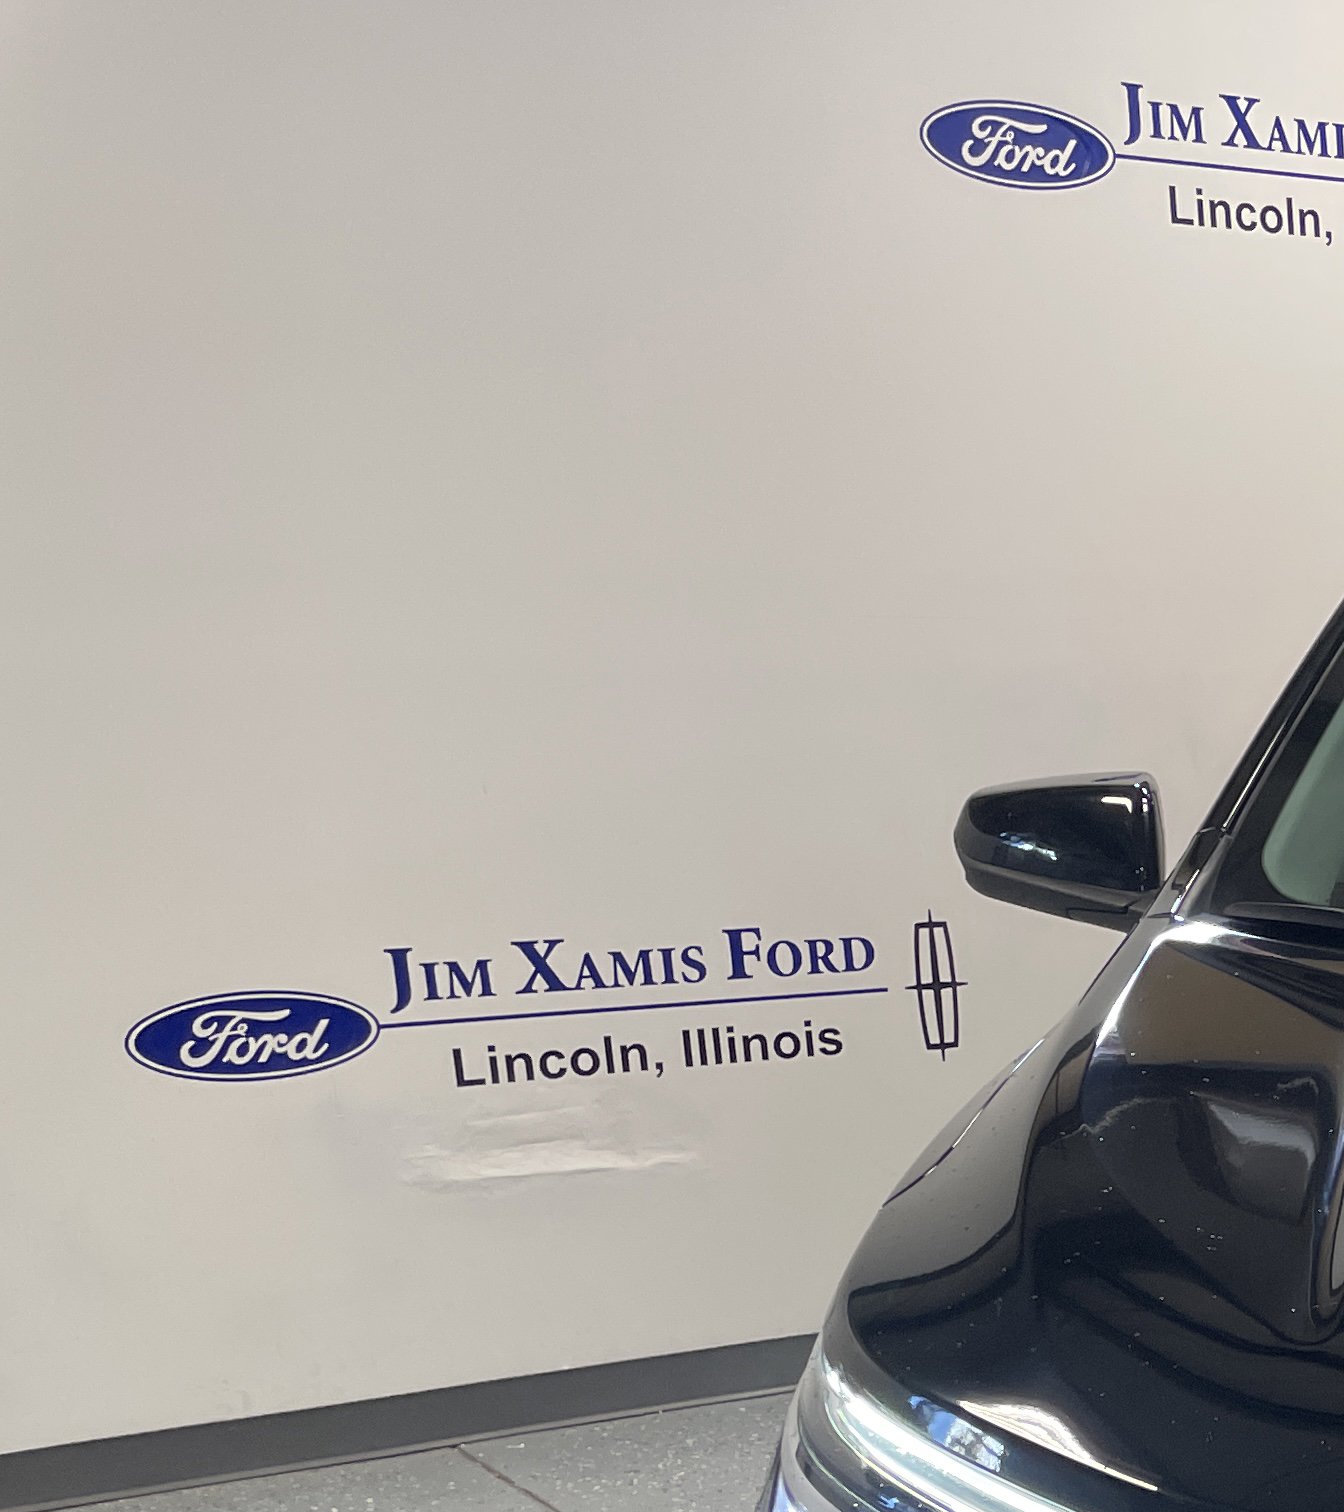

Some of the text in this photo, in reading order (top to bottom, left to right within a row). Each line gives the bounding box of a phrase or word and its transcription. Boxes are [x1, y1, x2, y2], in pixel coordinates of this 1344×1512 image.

[1121, 81, 1205, 146] JIM
[960, 114, 1077, 179] Ford
[1168, 186, 1333, 246] Lincoln,
[384, 927, 876, 1015] JIM XAMIS FORD
[179, 1009, 330, 1068] Ford
[452, 1018, 844, 1088] Lincoln, Illinois
